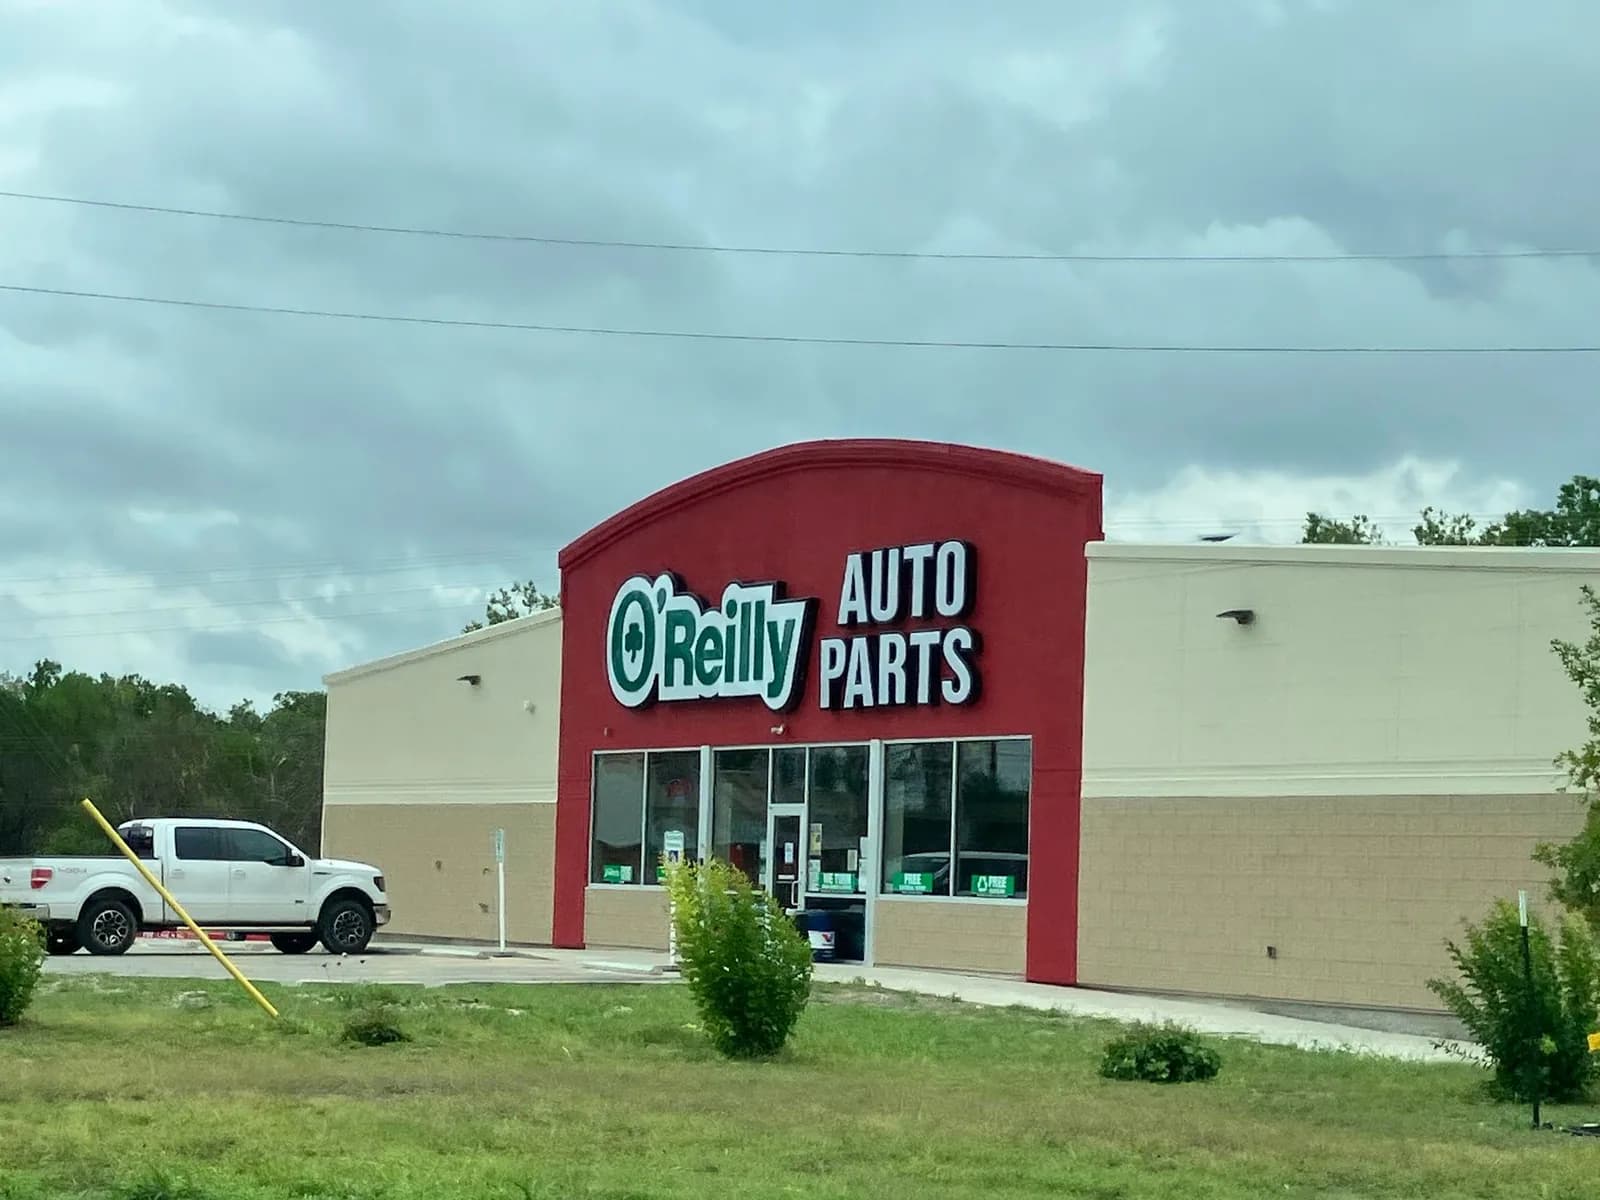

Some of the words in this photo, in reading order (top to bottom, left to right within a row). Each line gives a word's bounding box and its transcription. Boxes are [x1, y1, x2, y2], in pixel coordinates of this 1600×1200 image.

[838, 541, 967, 625] AUTO
[610, 586, 797, 699] O'Reilly
[820, 628, 973, 709] PARTS
[988, 875, 1007, 888] FREE
